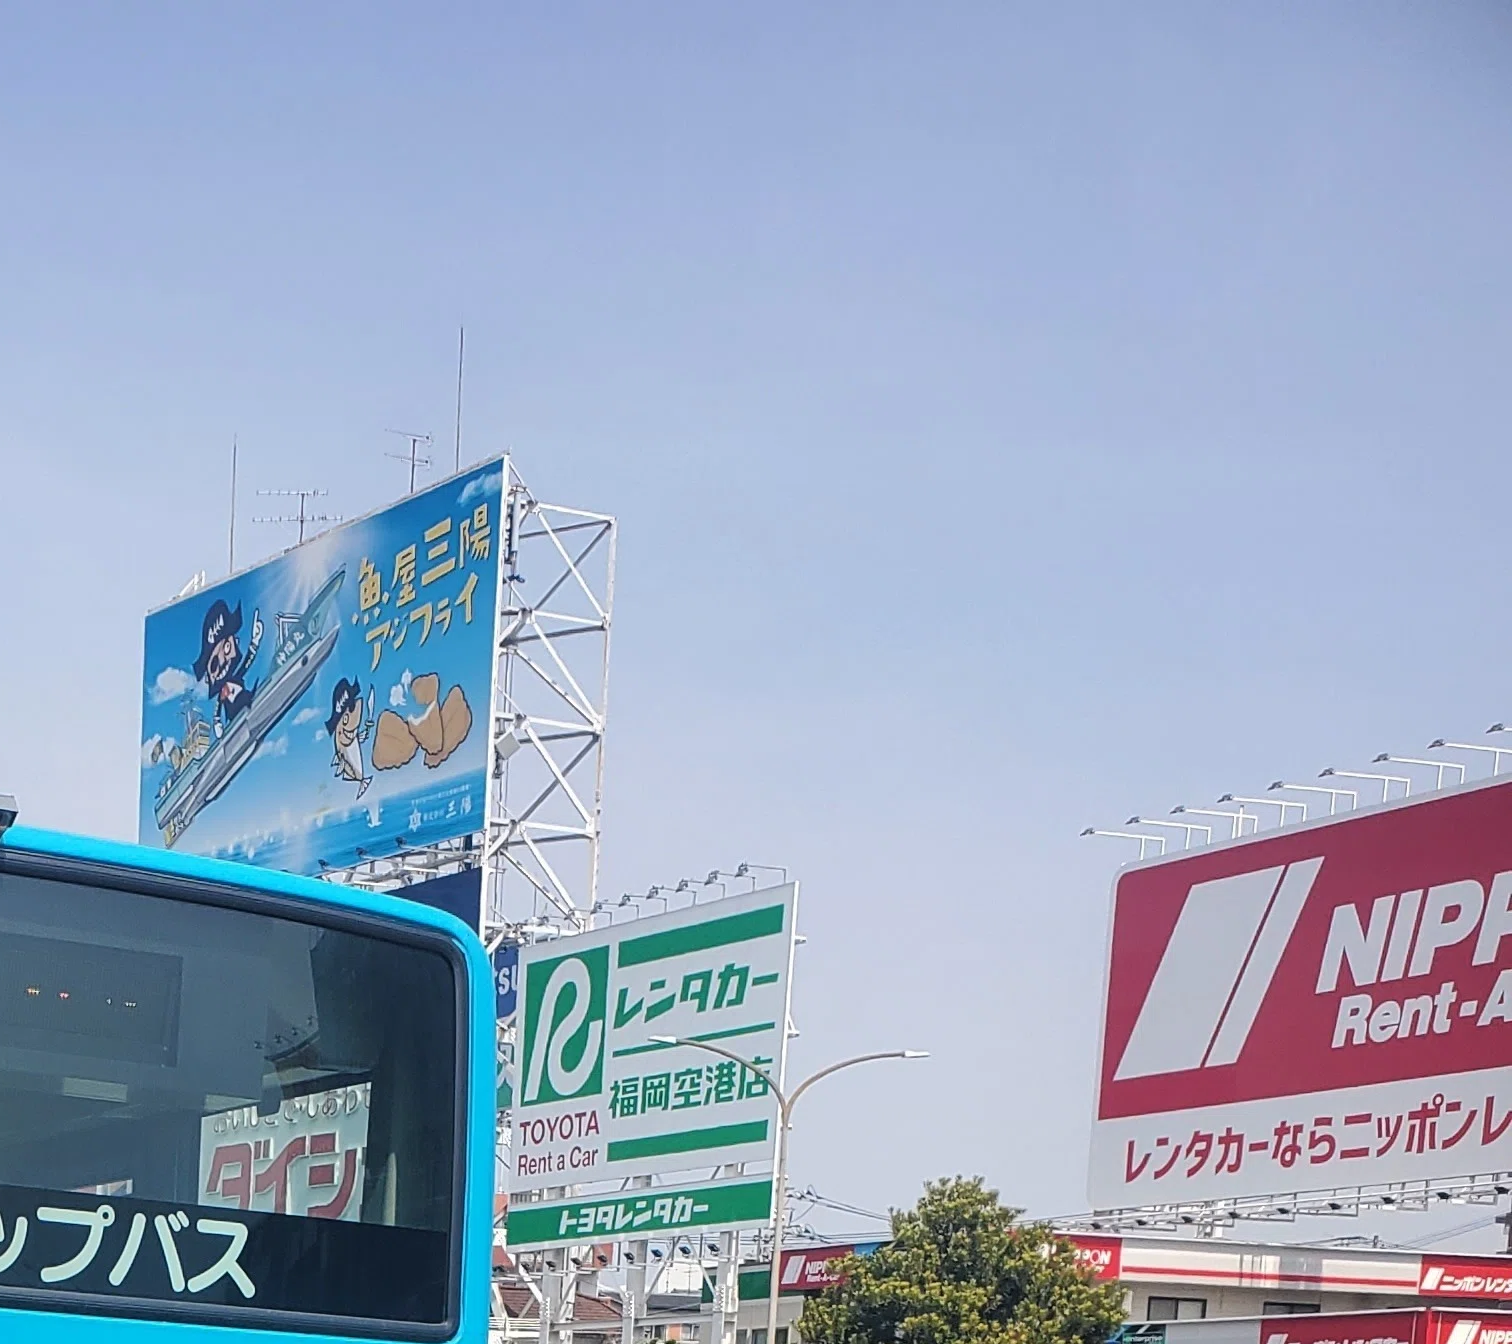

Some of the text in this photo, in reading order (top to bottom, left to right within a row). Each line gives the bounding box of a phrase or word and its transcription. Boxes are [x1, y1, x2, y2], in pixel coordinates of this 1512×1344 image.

[352, 503, 491, 625] 魚屋三陽
[366, 572, 479, 672] アジフライ
[613, 962, 779, 1030] レンタカー
[608, 1056, 773, 1119] 福岡空港店
[519, 1110, 600, 1146] TOYOTA
[1125, 1092, 1512, 1184] レンタカーならニッポンレ
[517, 1146, 599, 1177] Rent a Car
[558, 1197, 709, 1235] トヨタレンタカー
